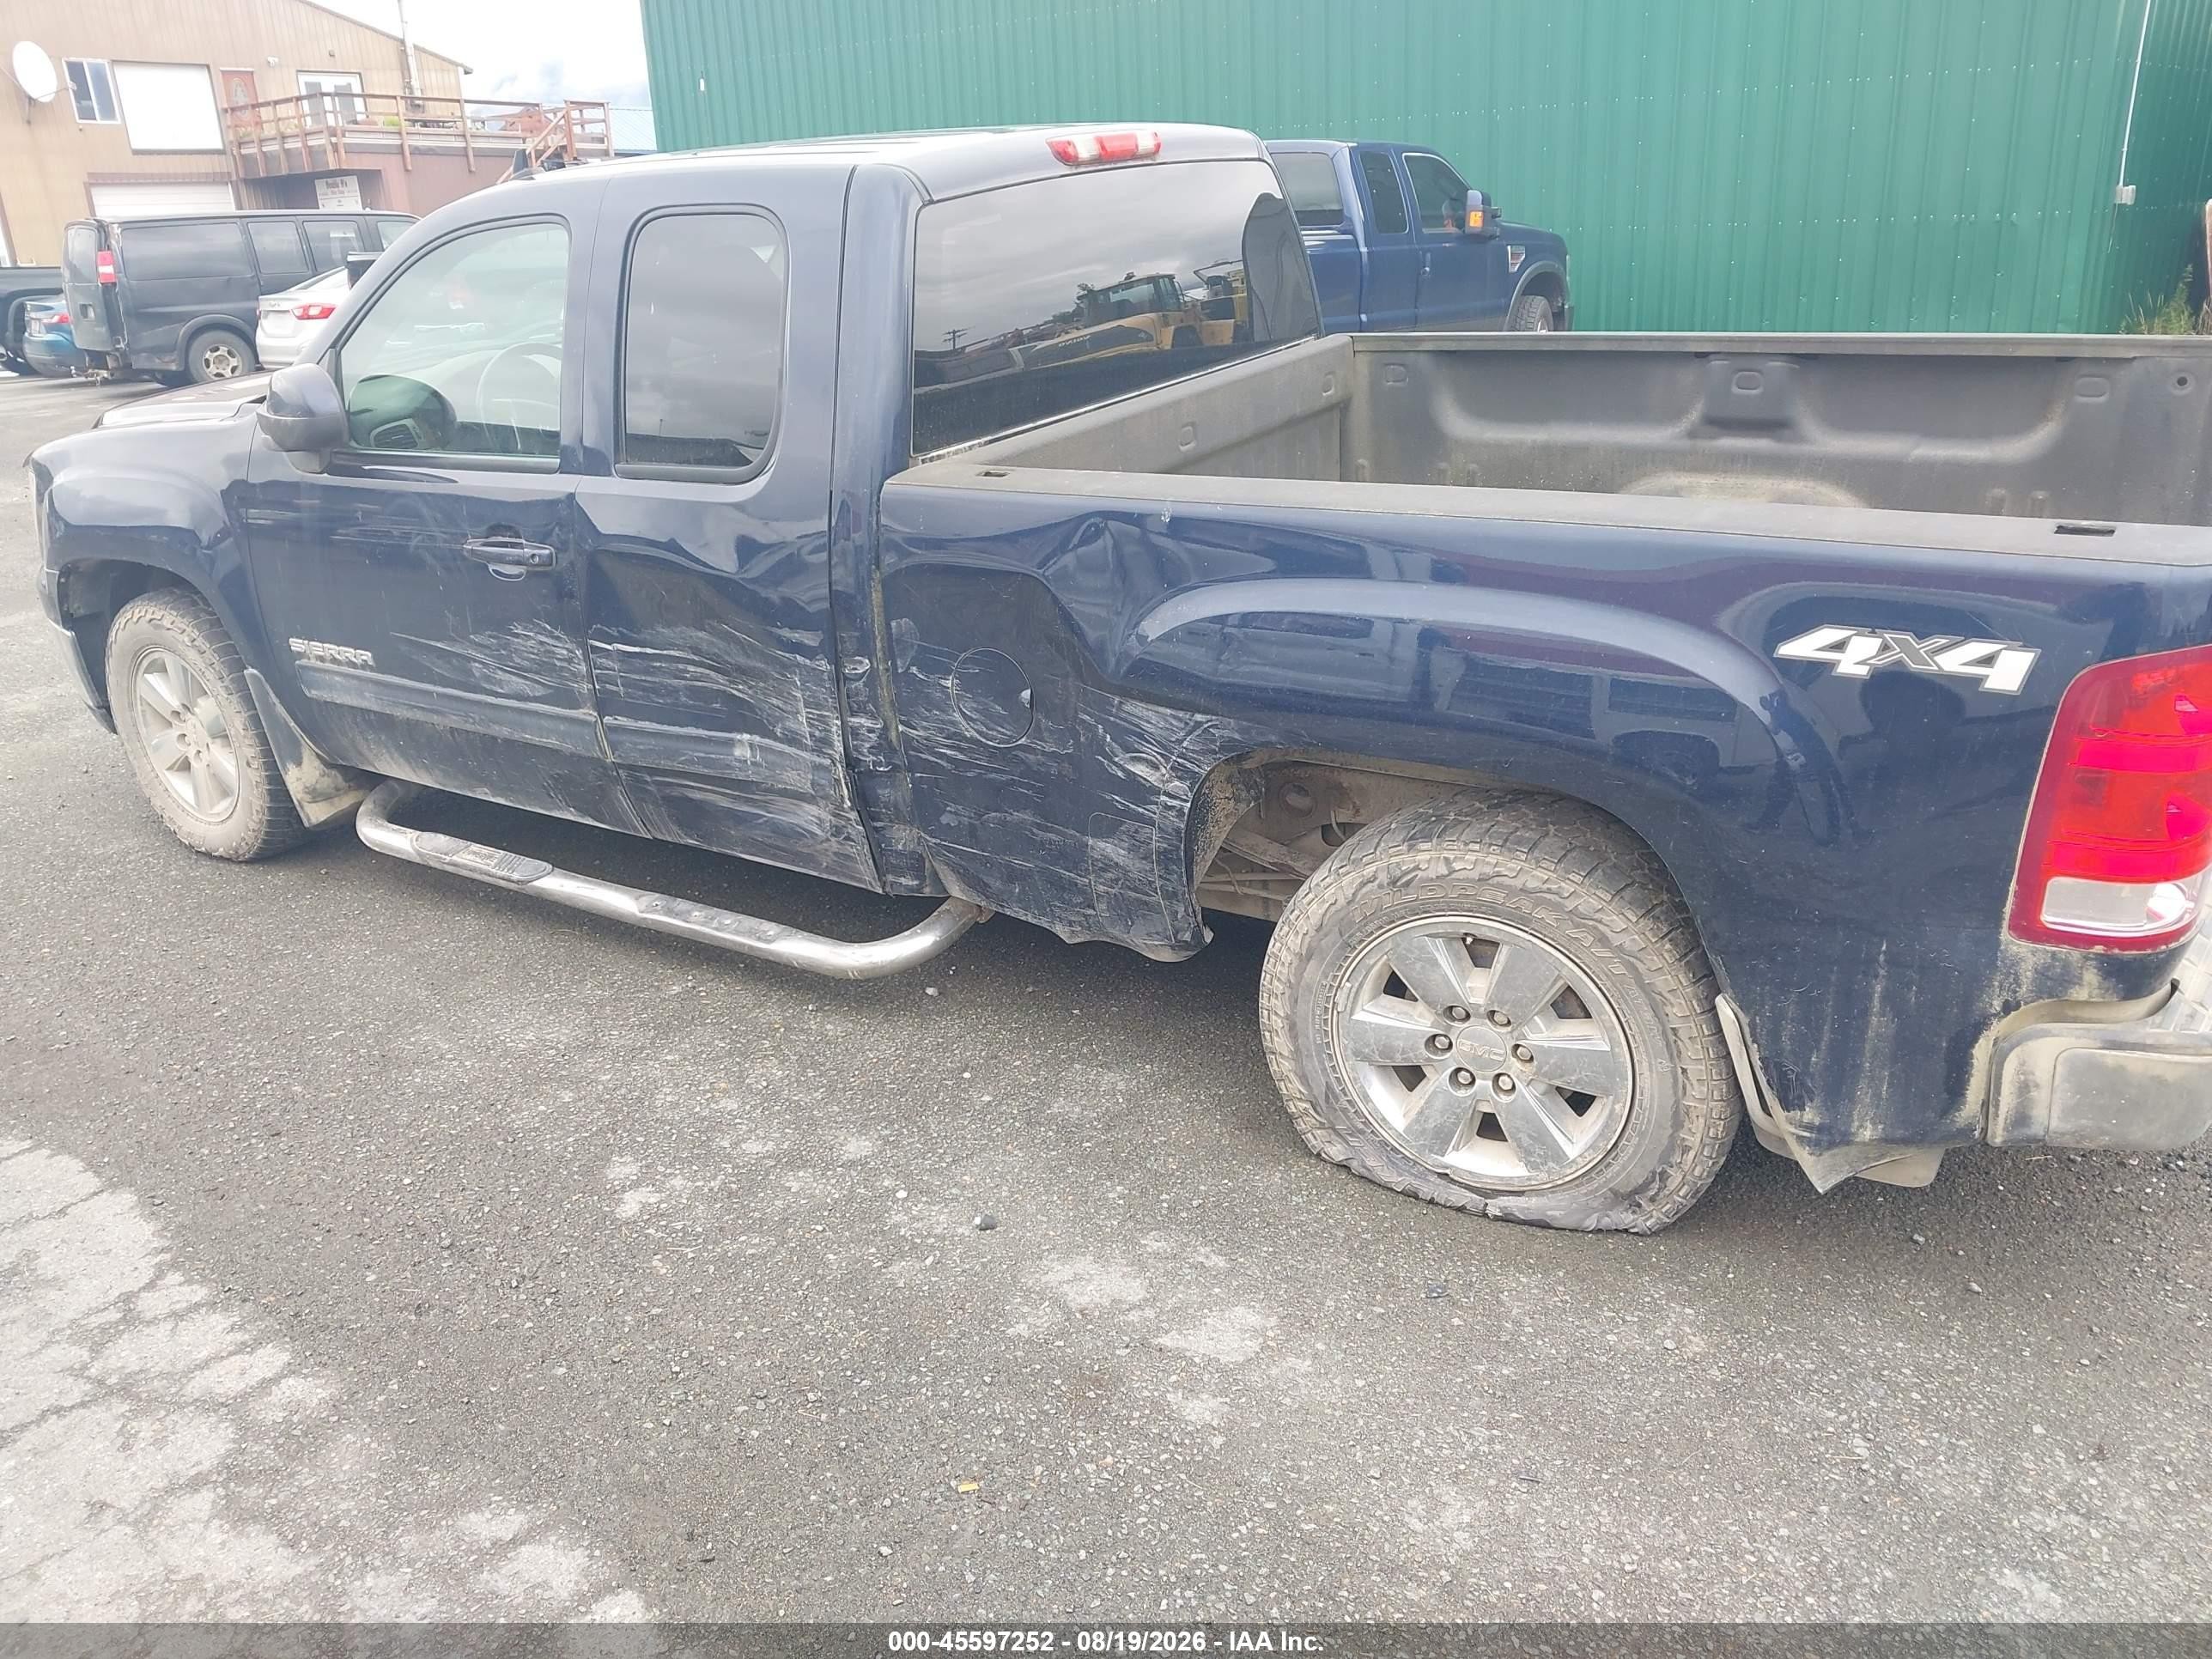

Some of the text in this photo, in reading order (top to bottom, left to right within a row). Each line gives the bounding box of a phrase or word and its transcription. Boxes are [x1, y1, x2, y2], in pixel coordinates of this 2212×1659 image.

[289, 637, 375, 667] SIERRA
[1352, 883, 1563, 927] WILDPEAK
[1458, 1039, 1505, 1062] GMC
